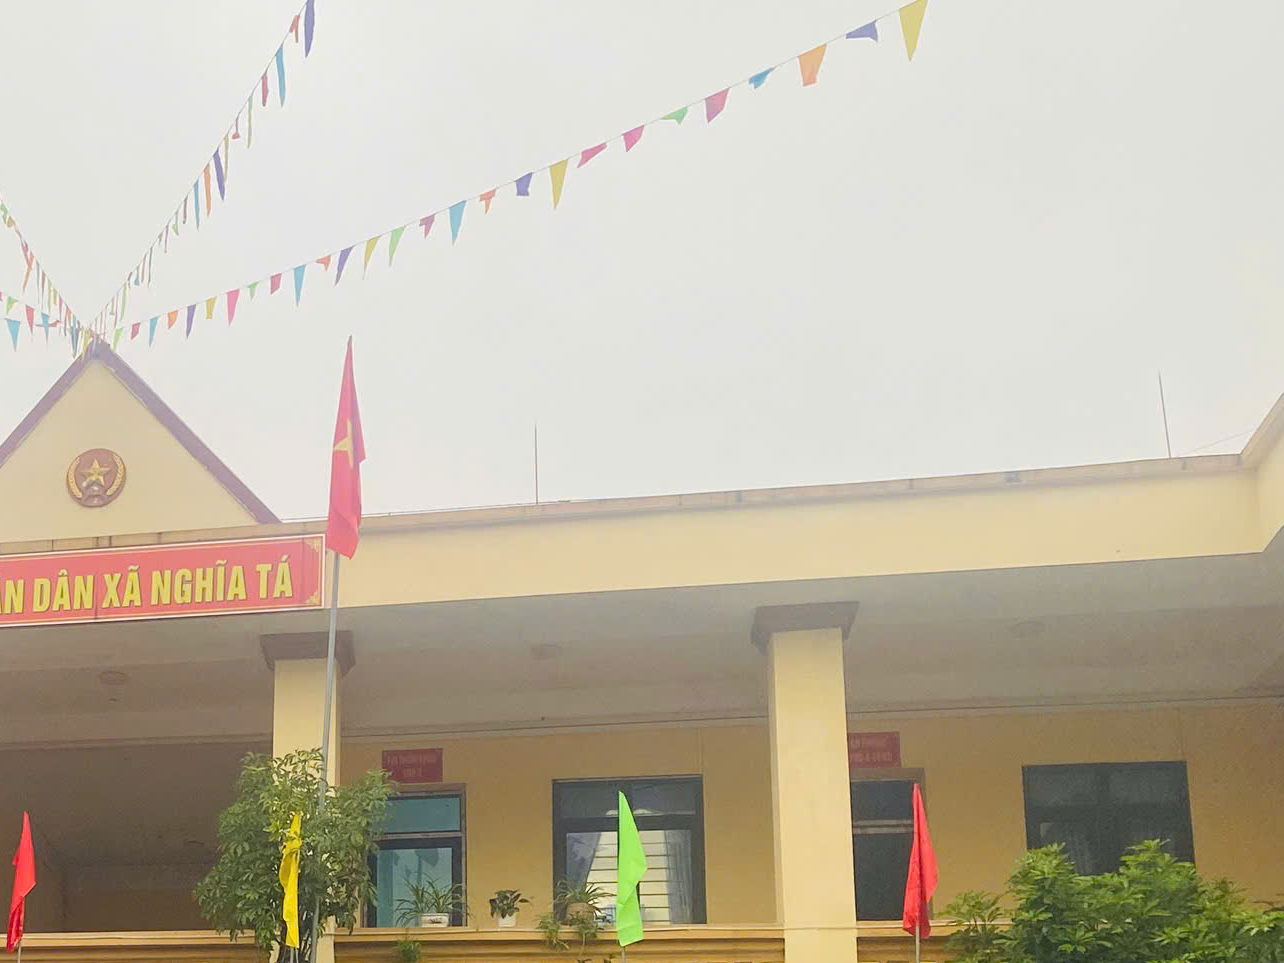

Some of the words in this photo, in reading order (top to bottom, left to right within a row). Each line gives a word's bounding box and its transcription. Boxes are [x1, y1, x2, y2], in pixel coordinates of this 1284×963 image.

[33, 569, 94, 613] DÂN
[101, 565, 141, 608] XÃ
[150, 558, 246, 606] NGHĨA
[256, 555, 293, 599] TÁ
